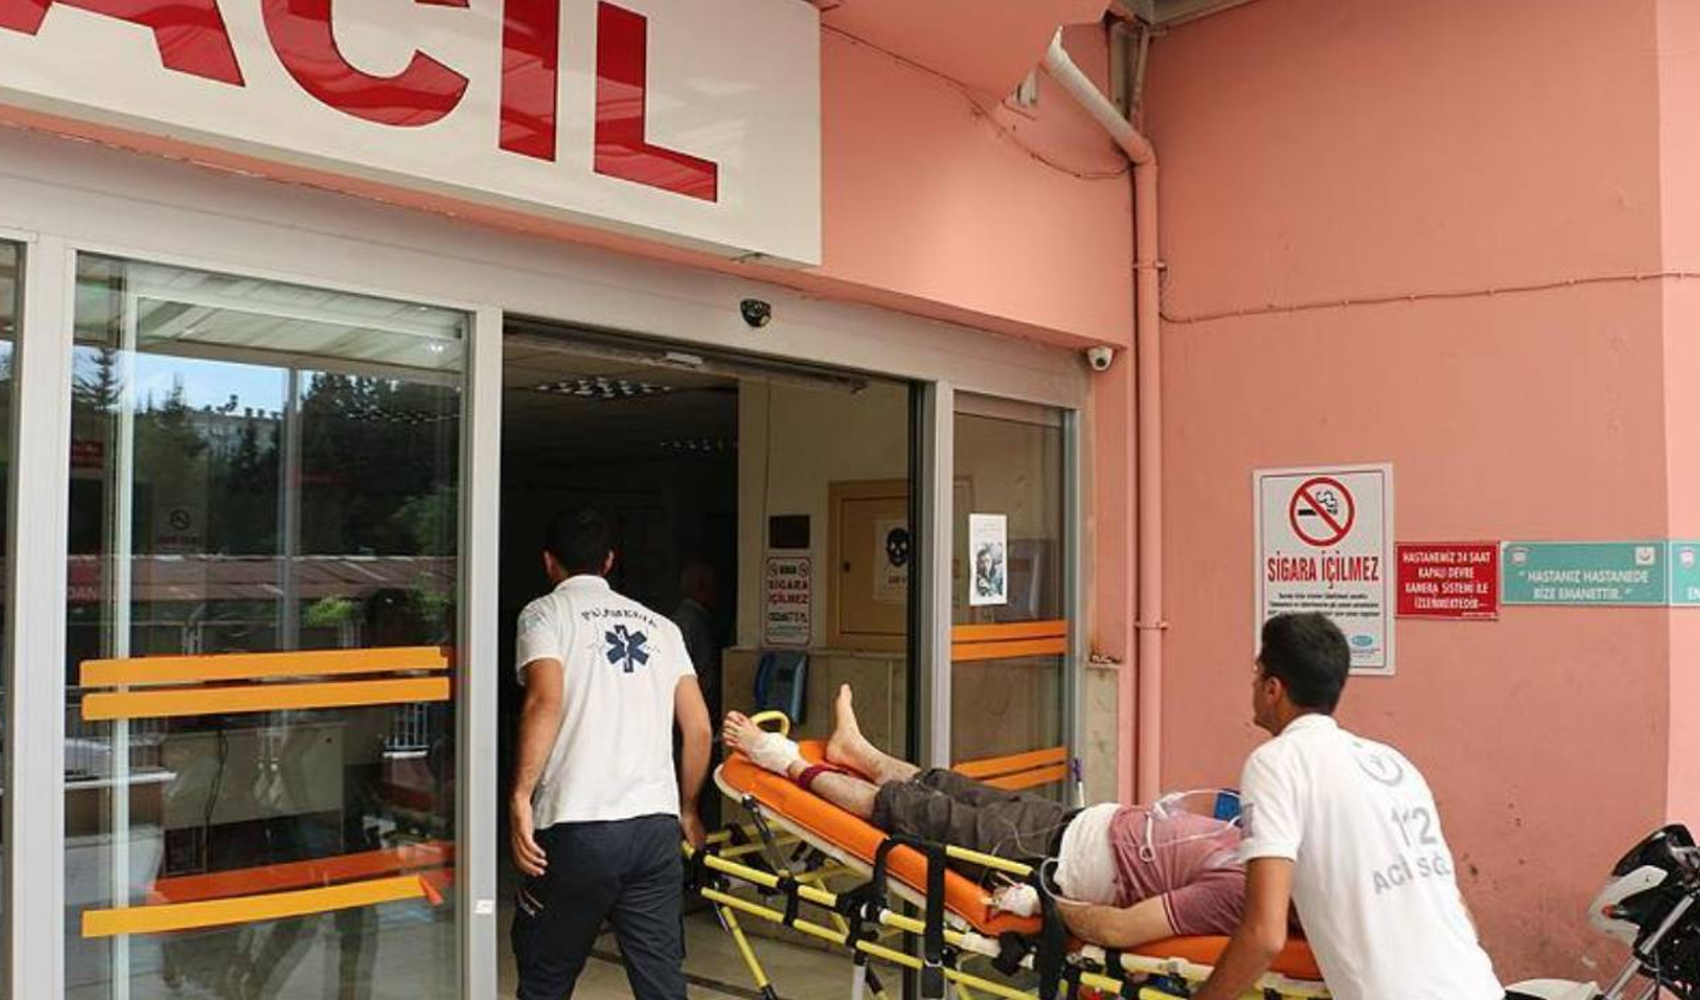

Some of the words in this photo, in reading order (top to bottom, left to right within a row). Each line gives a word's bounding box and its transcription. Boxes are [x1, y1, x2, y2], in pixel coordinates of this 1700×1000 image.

[1267, 551, 1317, 582] SİGARA
[1321, 551, 1379, 589] İÇİLMEZ
[1448, 567, 1474, 578] DEVRE
[1405, 582, 1439, 594] KAMERA
